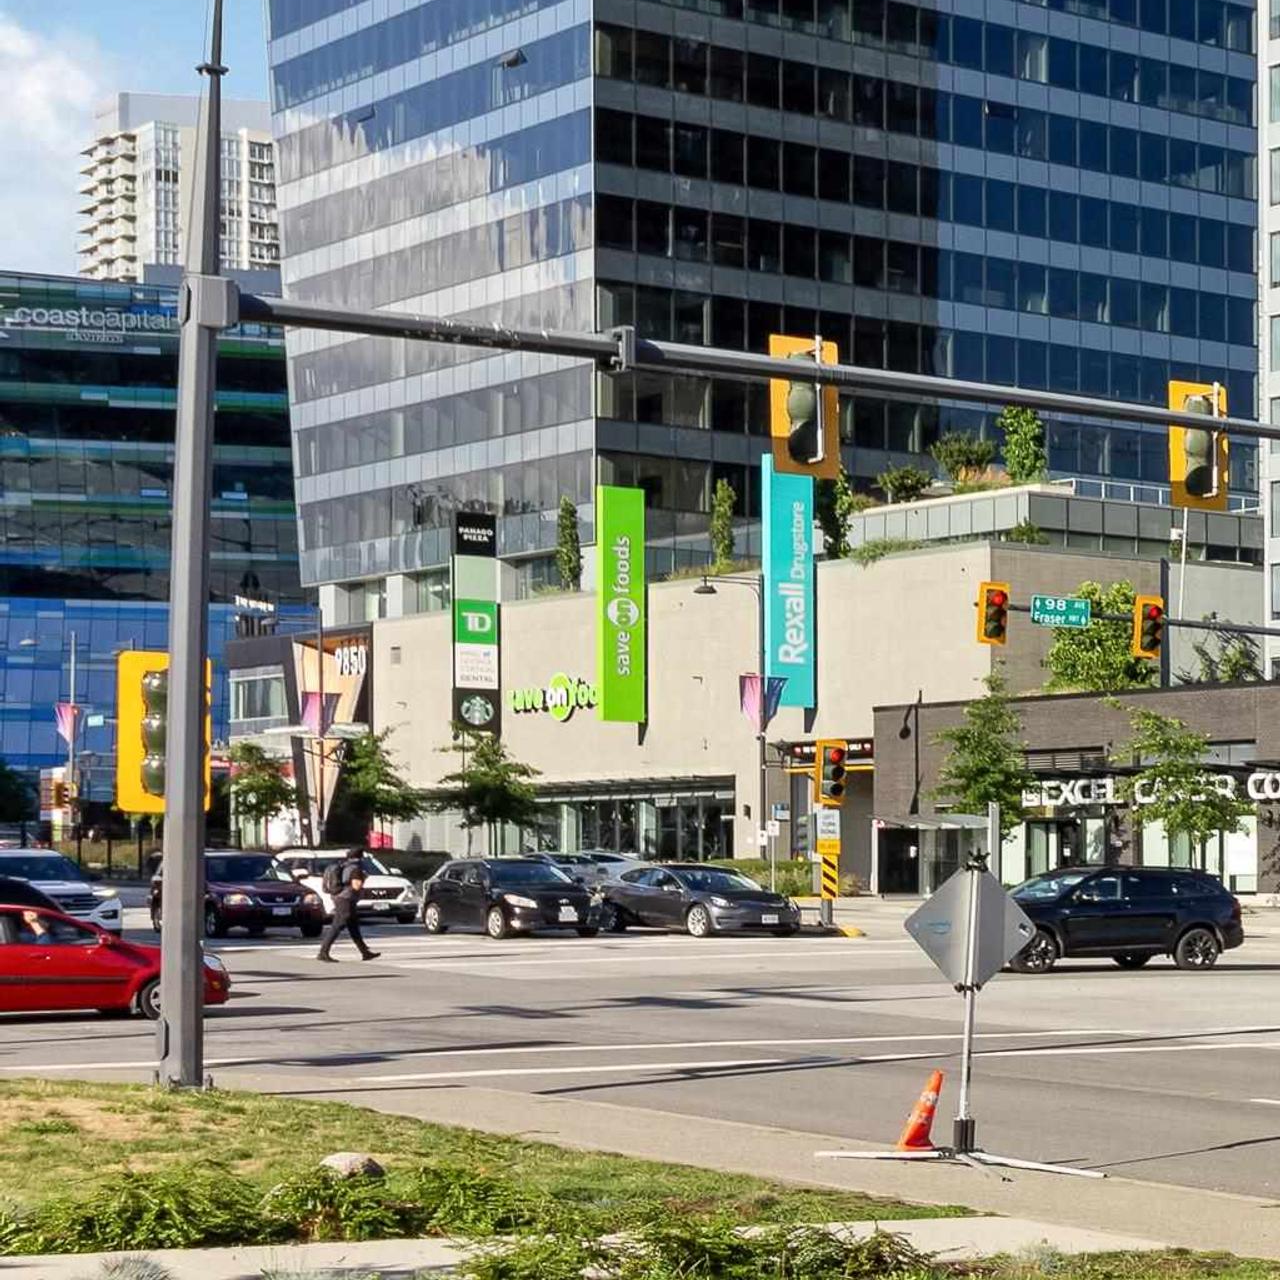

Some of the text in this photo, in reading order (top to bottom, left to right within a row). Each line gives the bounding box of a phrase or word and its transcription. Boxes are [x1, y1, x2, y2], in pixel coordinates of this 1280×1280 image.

[612, 535, 631, 593] foods
[778, 501, 809, 664] Rexall Drugstore
[1033, 611, 1066, 625] Fraser
[1044, 599, 1067, 611] 98
[461, 612, 492, 632] TD
[334, 644, 367, 675] 9850
[617, 631, 631, 677] save
[1041, 777, 1124, 806] EXCEL
